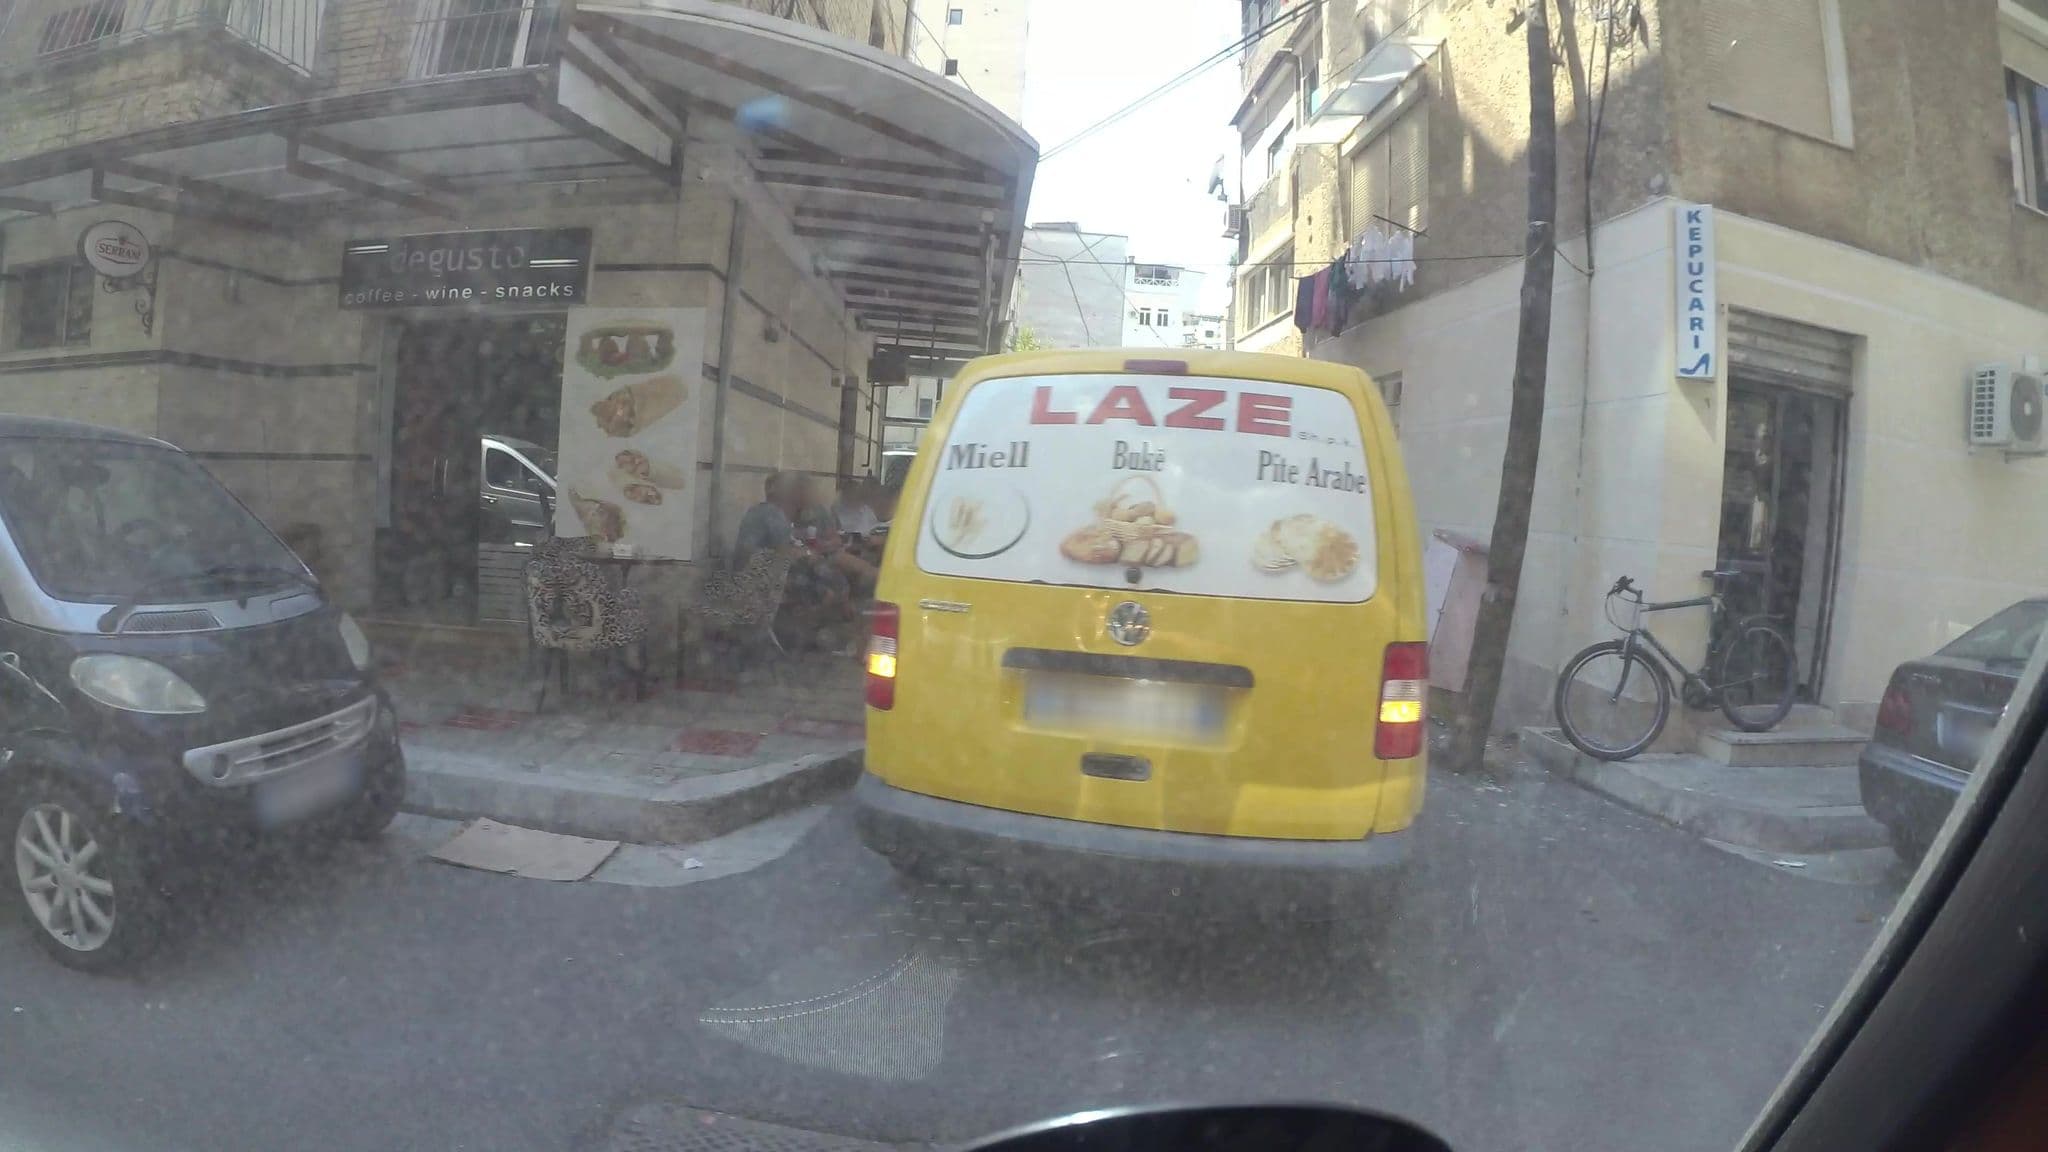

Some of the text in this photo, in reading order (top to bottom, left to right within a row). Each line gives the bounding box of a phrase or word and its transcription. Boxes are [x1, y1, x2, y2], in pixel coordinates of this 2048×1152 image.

[390, 242, 525, 278] degusto
[1687, 210, 1704, 349] KEPUCARI
[345, 288, 404, 305] coffee
[425, 284, 473, 299] wine
[495, 282, 575, 298] snacks
[1030, 385, 1292, 438] LAZE
[946, 440, 1030, 471] Miell
[1257, 449, 1366, 495] Pite Arabe
